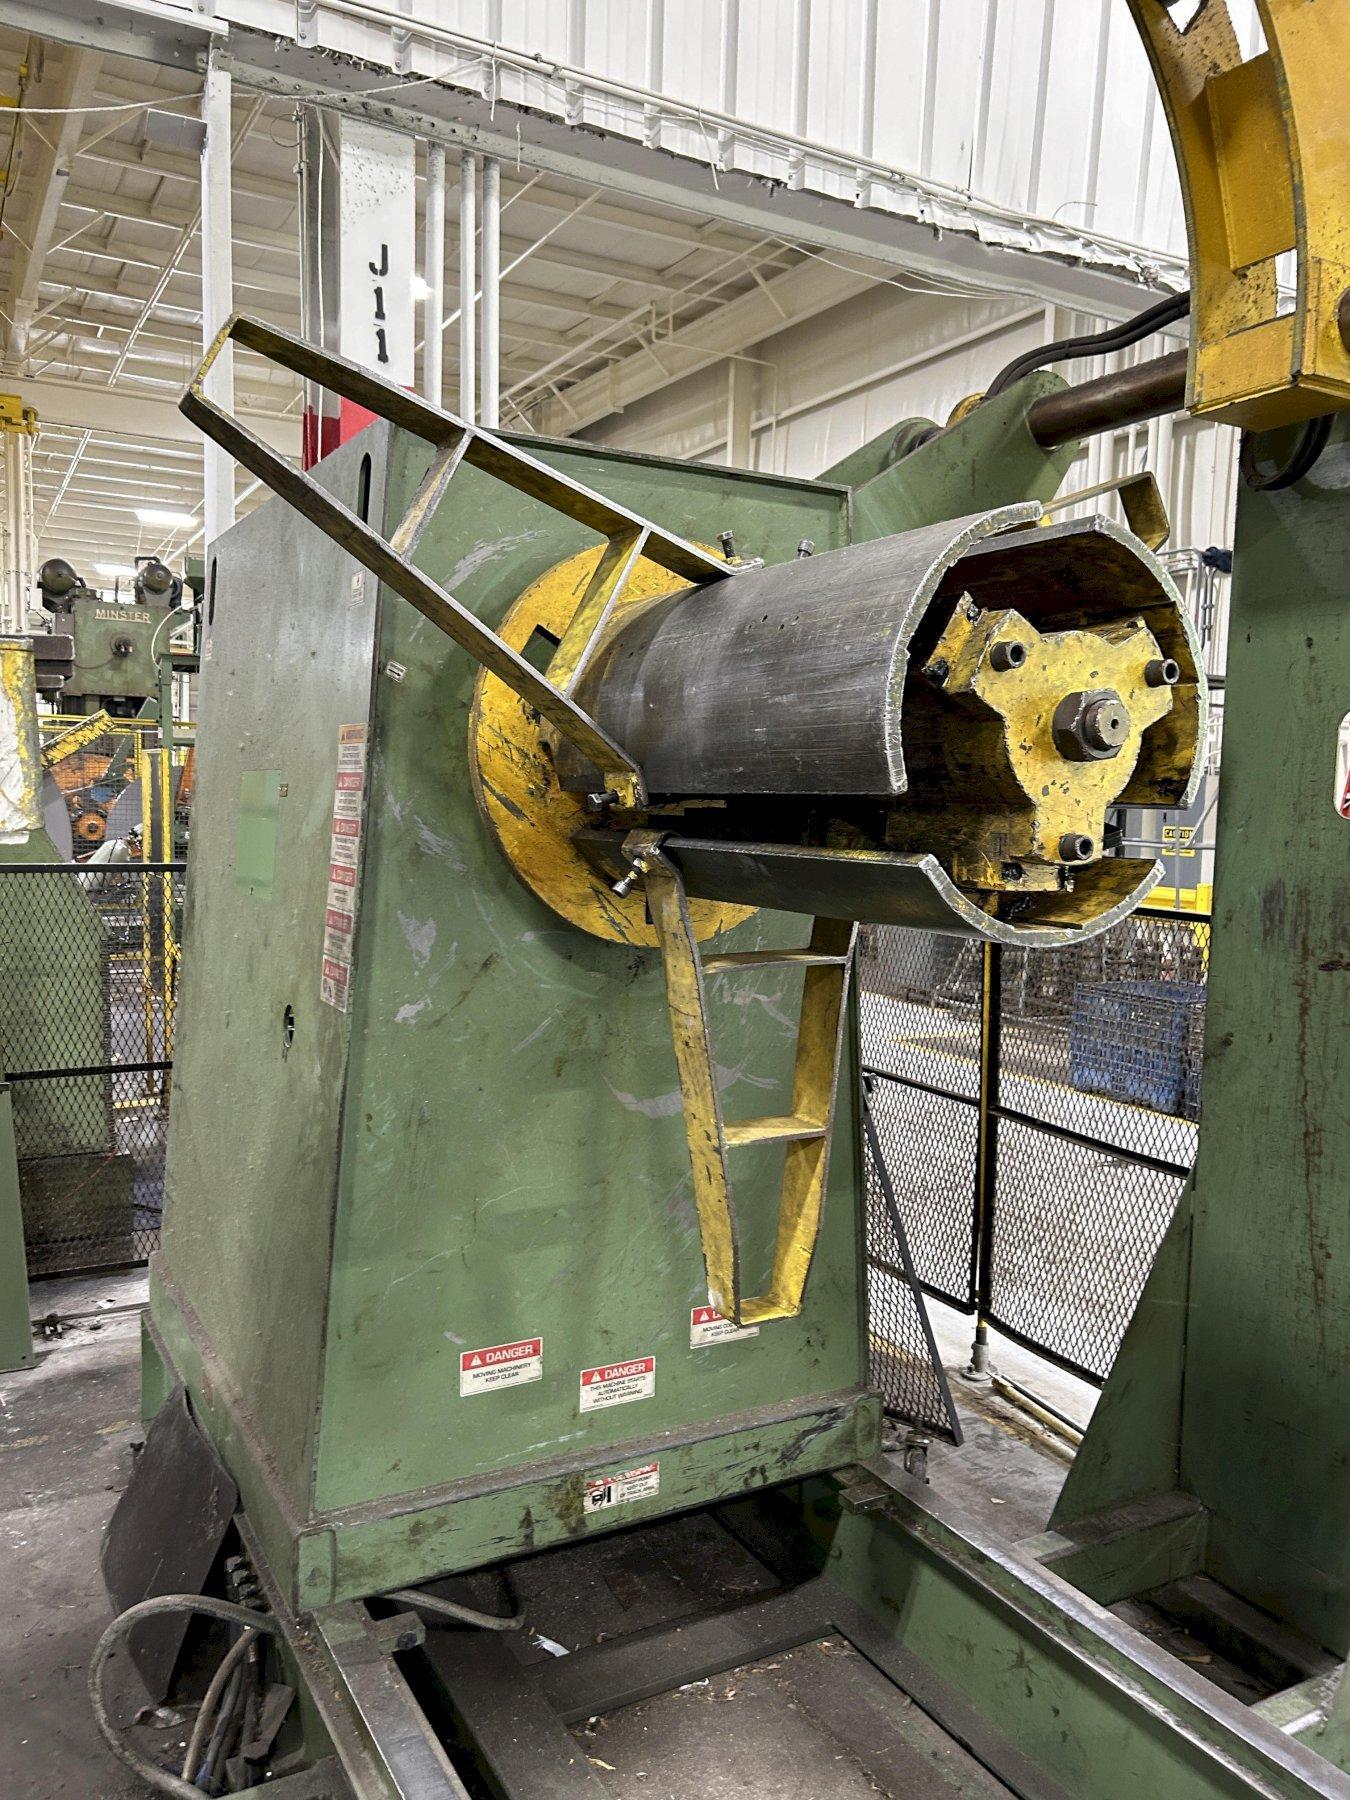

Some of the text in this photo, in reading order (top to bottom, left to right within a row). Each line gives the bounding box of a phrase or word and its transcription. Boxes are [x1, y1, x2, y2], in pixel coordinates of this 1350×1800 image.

[96, 608, 151, 622] MINSTER
[486, 1344, 533, 1363] DANGER
[473, 1362, 531, 1379] MOVING MACHINERY
[485, 1374, 500, 1383] KEEP
[500, 1371, 520, 1380] CLEAR
[604, 1362, 646, 1379] DANGER
[603, 1379, 625, 1388] MACHINE
[627, 1375, 646, 1383] STARTS
[592, 1388, 643, 1403] WITHOUT WARNING
[597, 1383, 638, 1396] AUTOMATICALLY
